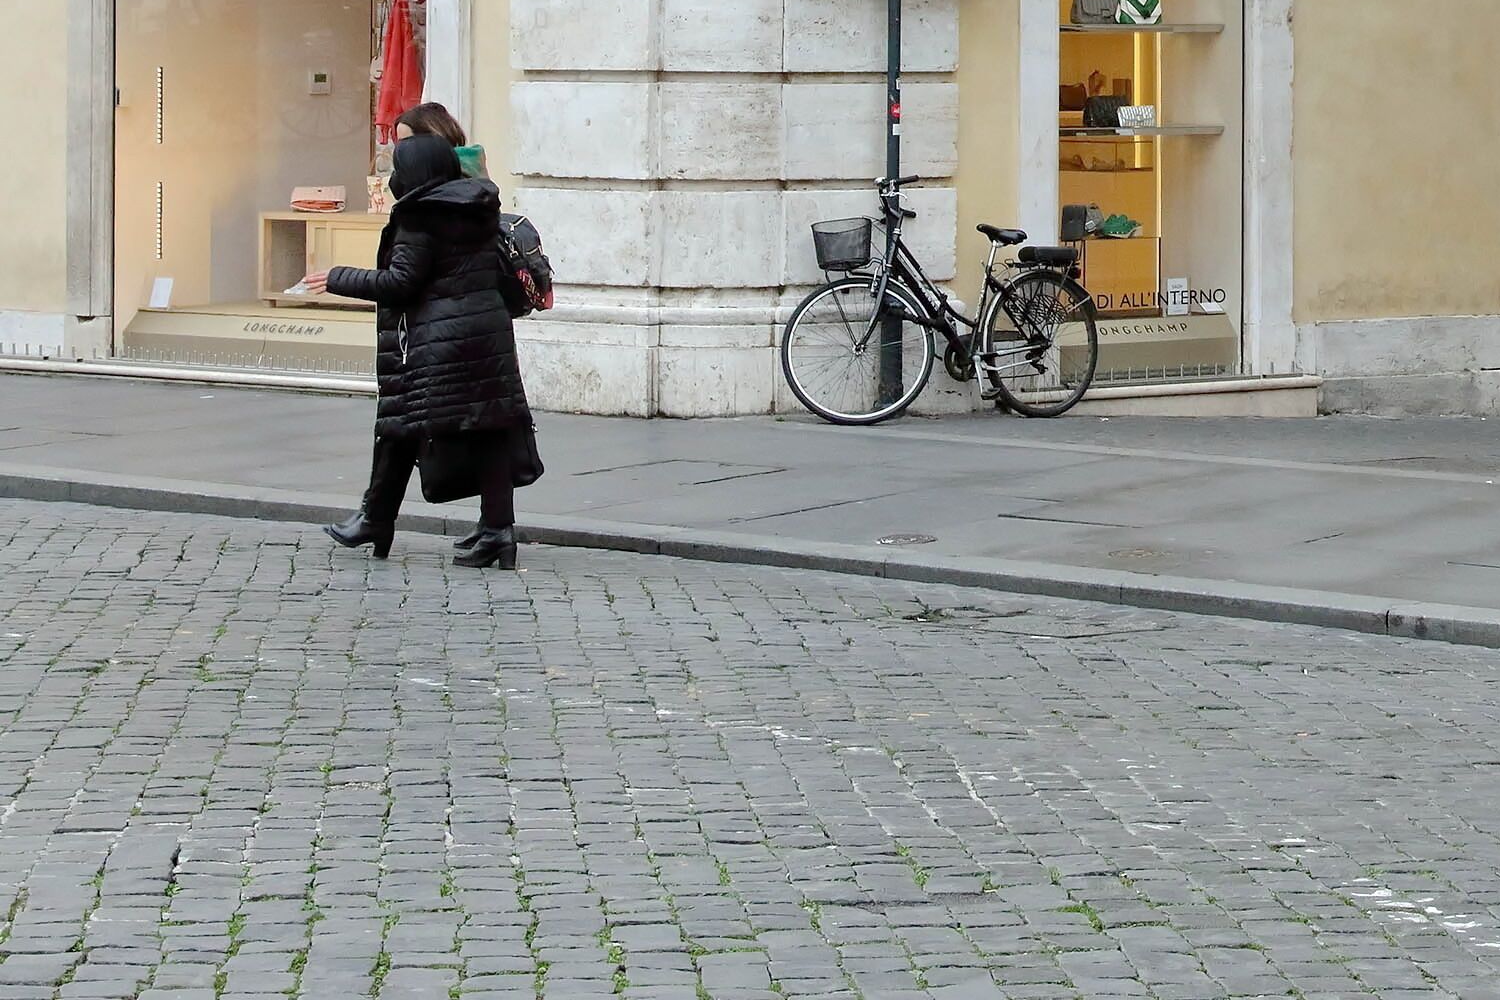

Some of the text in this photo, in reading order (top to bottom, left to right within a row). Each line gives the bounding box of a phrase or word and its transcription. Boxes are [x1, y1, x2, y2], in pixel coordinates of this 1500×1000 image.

[1120, 288, 1227, 308] ALL'INTERNO
[243, 322, 324, 336] LONGCHAMP
[1099, 322, 1189, 336] ONGCHAMP
